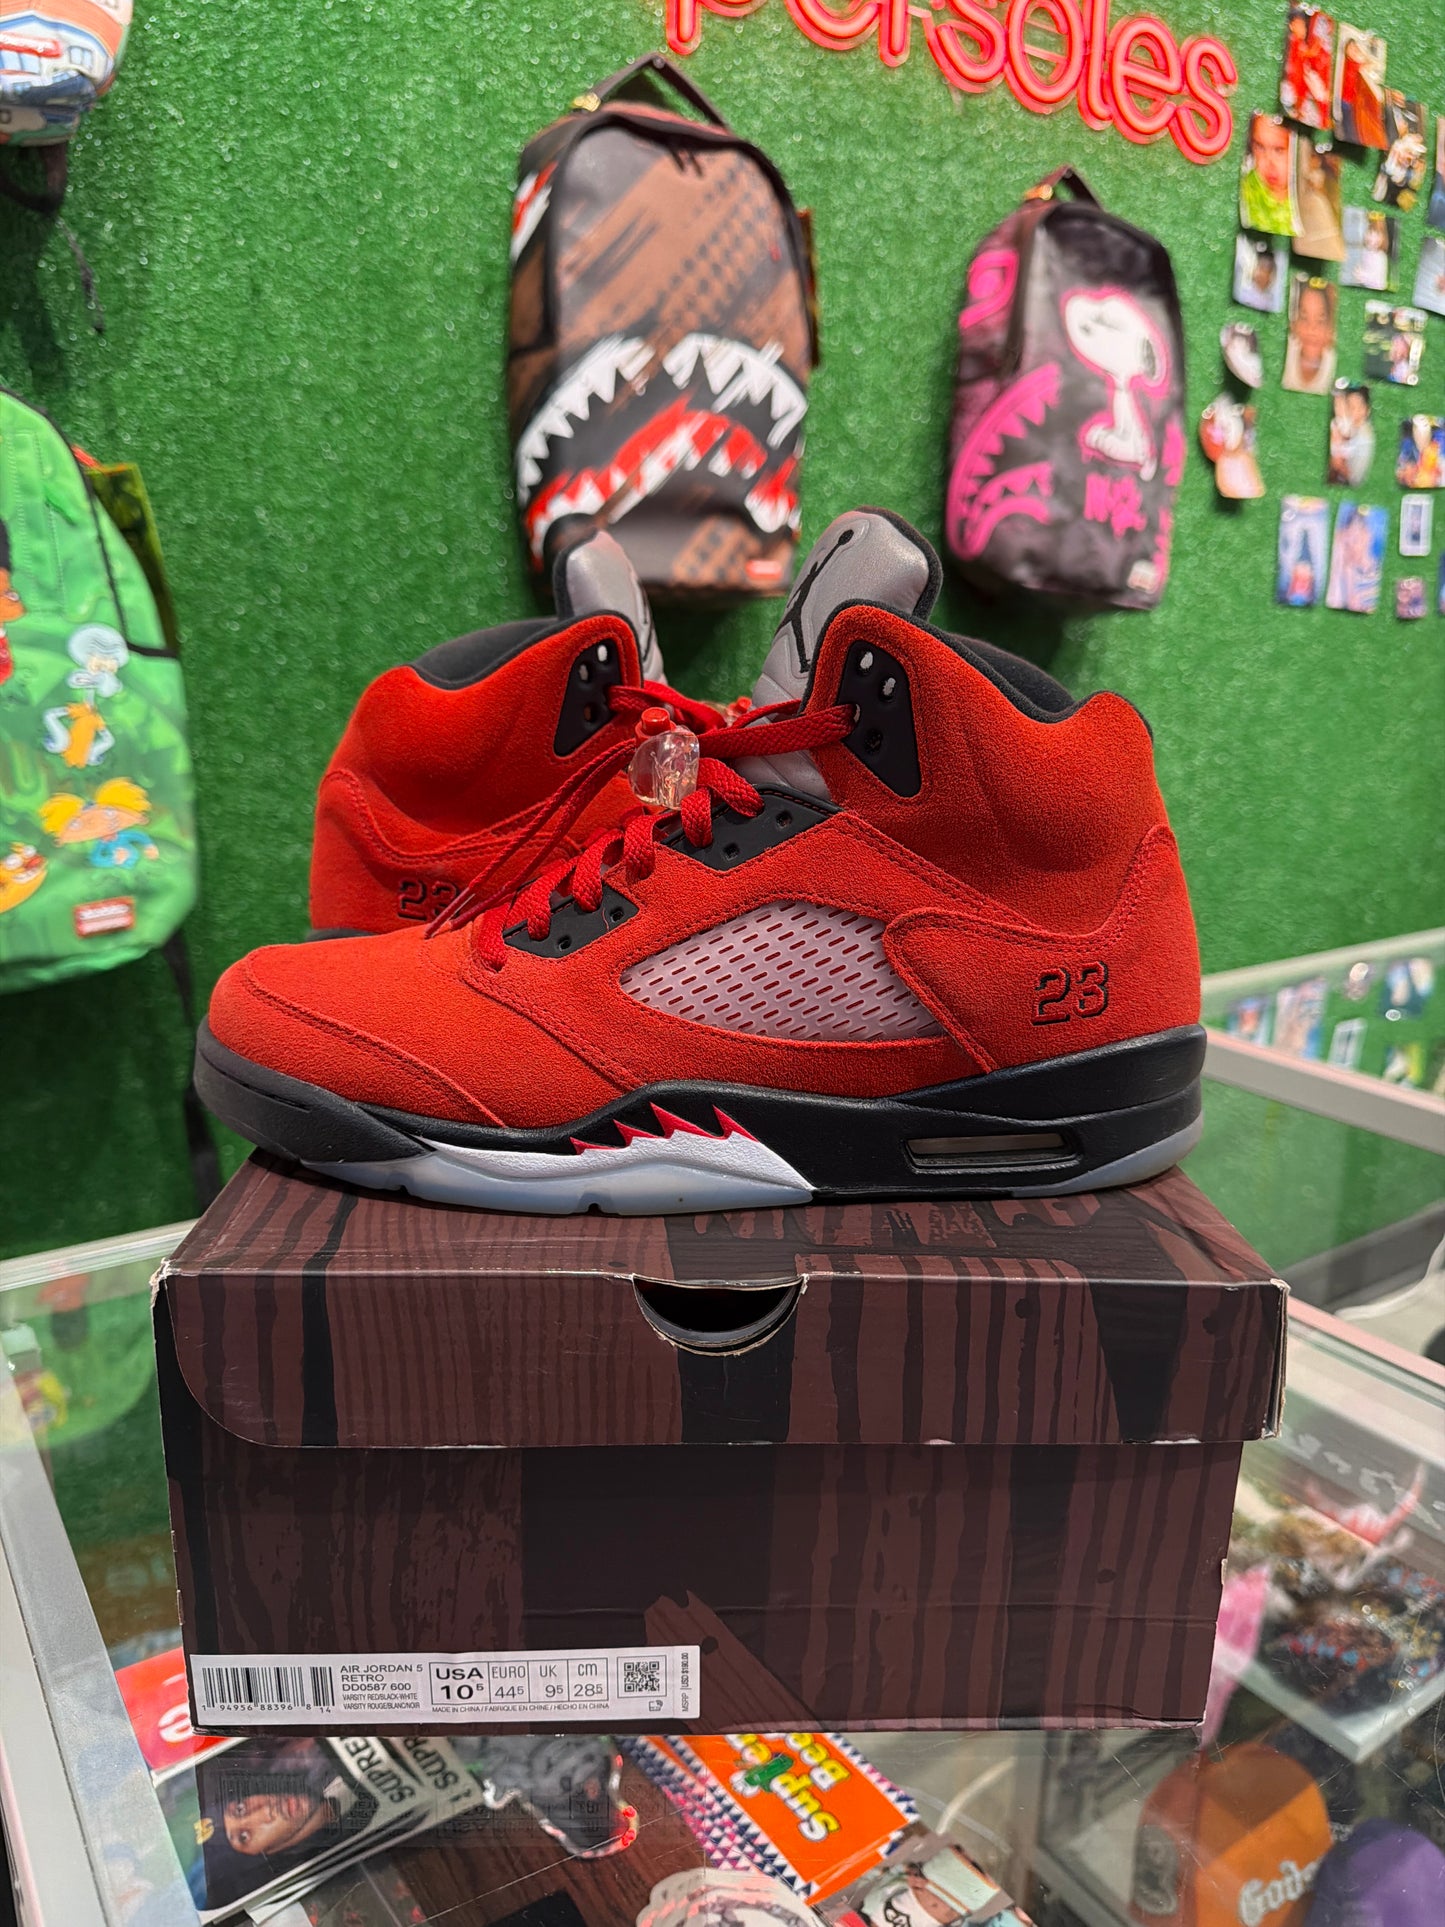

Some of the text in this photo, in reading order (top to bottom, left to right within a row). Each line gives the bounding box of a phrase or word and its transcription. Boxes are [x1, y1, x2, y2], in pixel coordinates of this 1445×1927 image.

[665, 0, 1238, 164] rsoles
[1030, 961, 1109, 1026] 23
[340, 1664, 423, 1674] AIR JORDAN 5
[436, 1667, 484, 1680] USA
[492, 1666, 526, 1679] EURO
[539, 1664, 558, 1678] UK
[341, 1674, 384, 1682] RETRO
[342, 1682, 411, 1692] DD0587 600
[342, 1693, 366, 1701] VARSITY
[220, 1704, 253, 1712] 94956
[343, 1702, 366, 1710] VARSITY
[528, 1704, 550, 1712] CHINE
[340, 1737, 415, 1803] SUPRE
